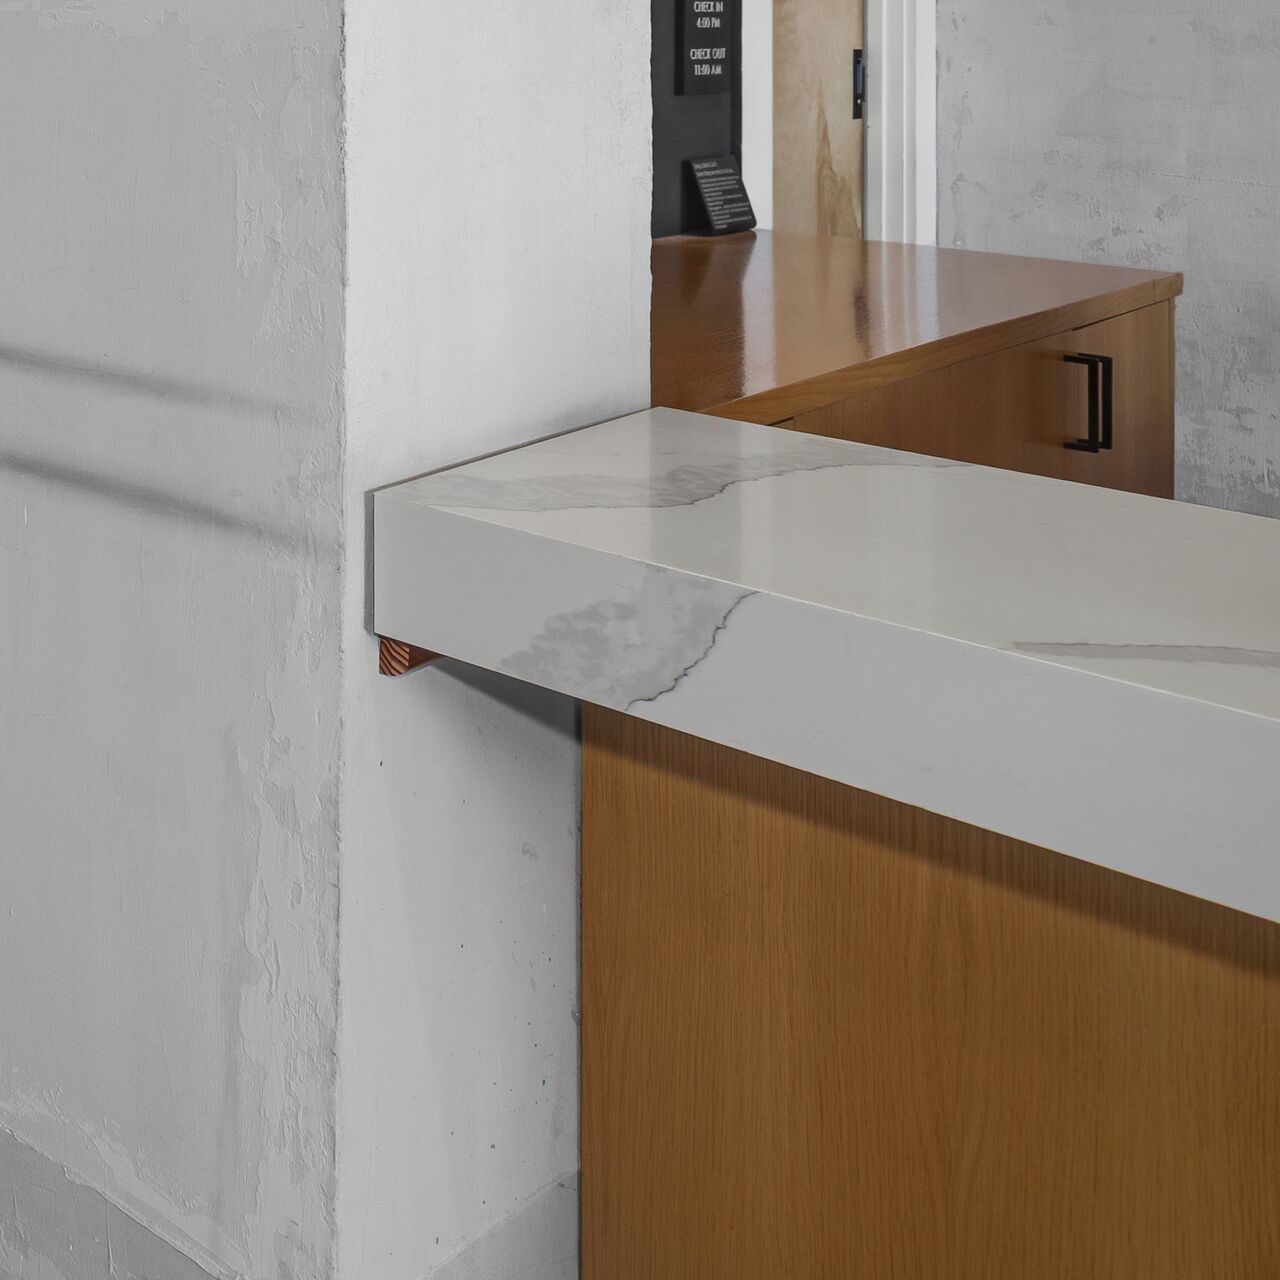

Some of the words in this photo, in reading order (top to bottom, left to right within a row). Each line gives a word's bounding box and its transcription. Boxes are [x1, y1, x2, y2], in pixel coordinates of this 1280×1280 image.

[693, 1, 714, 13] CHECK
[715, 1, 724, 13] IN
[696, 17, 711, 28] 4:00
[711, 17, 721, 28] PM
[690, 48, 712, 60] CHECK
[712, 47, 727, 59] OUT
[694, 64, 710, 76] 11:00
[711, 65, 722, 75] AM
